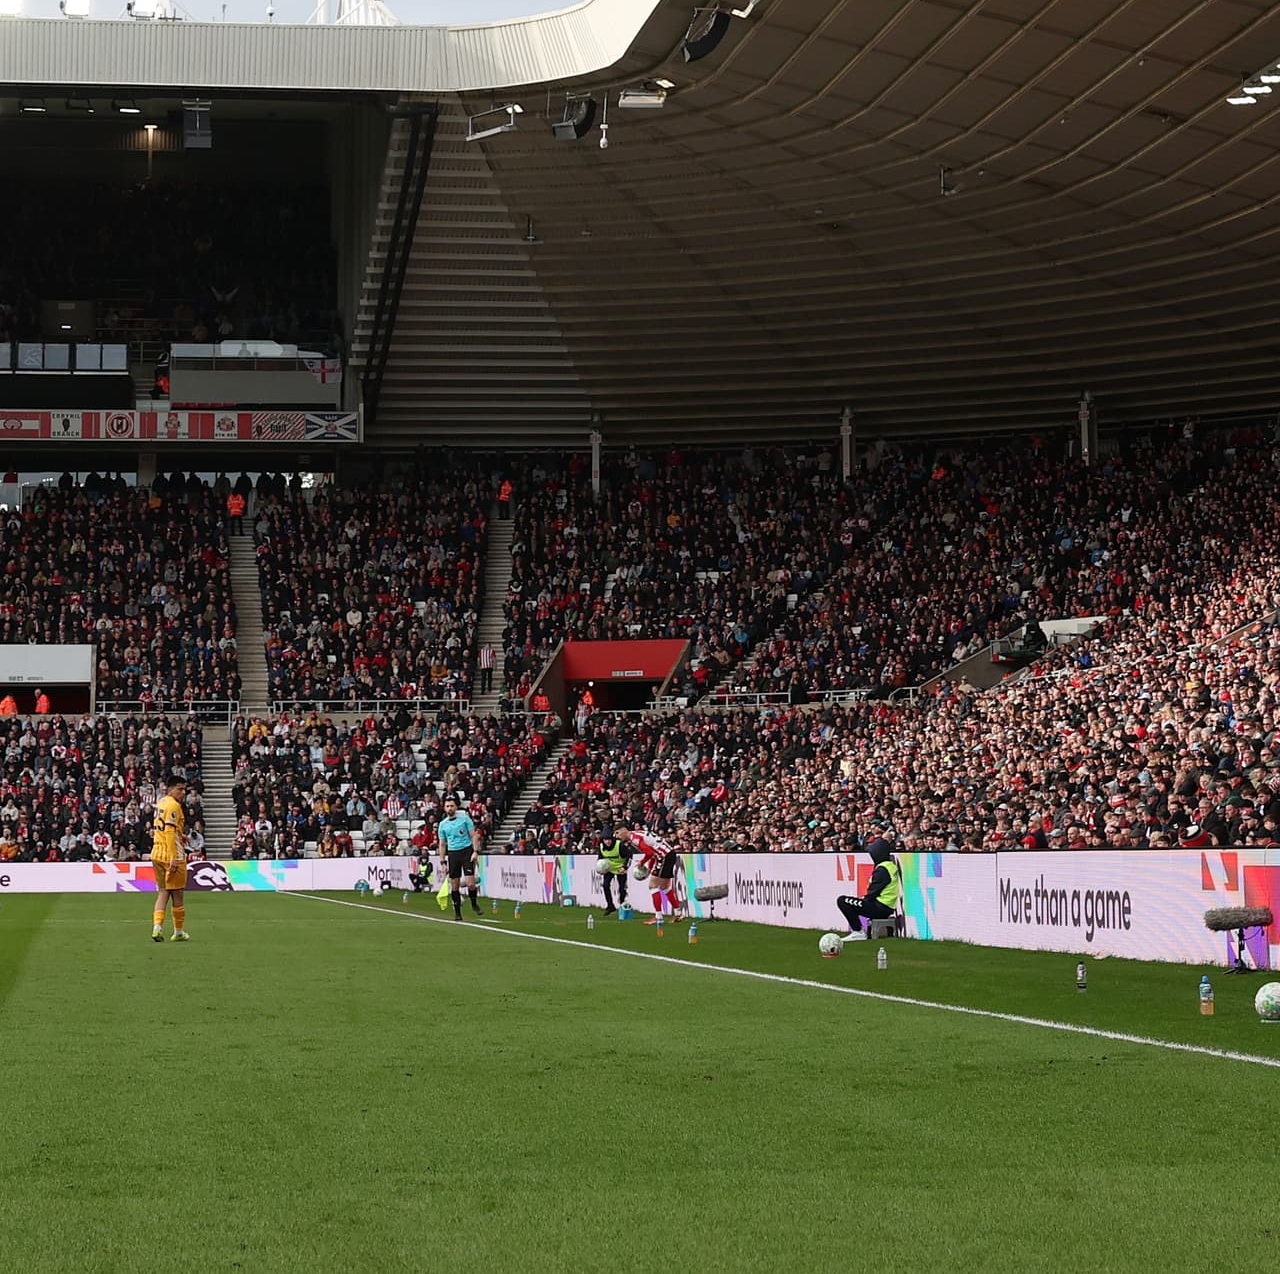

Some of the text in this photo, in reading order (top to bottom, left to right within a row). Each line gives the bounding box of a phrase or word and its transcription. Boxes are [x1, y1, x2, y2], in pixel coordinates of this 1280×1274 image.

[734, 871, 755, 905] More
[755, 870, 777, 907] than
[782, 880, 804, 917] game
[1000, 874, 1132, 943] More than a game
